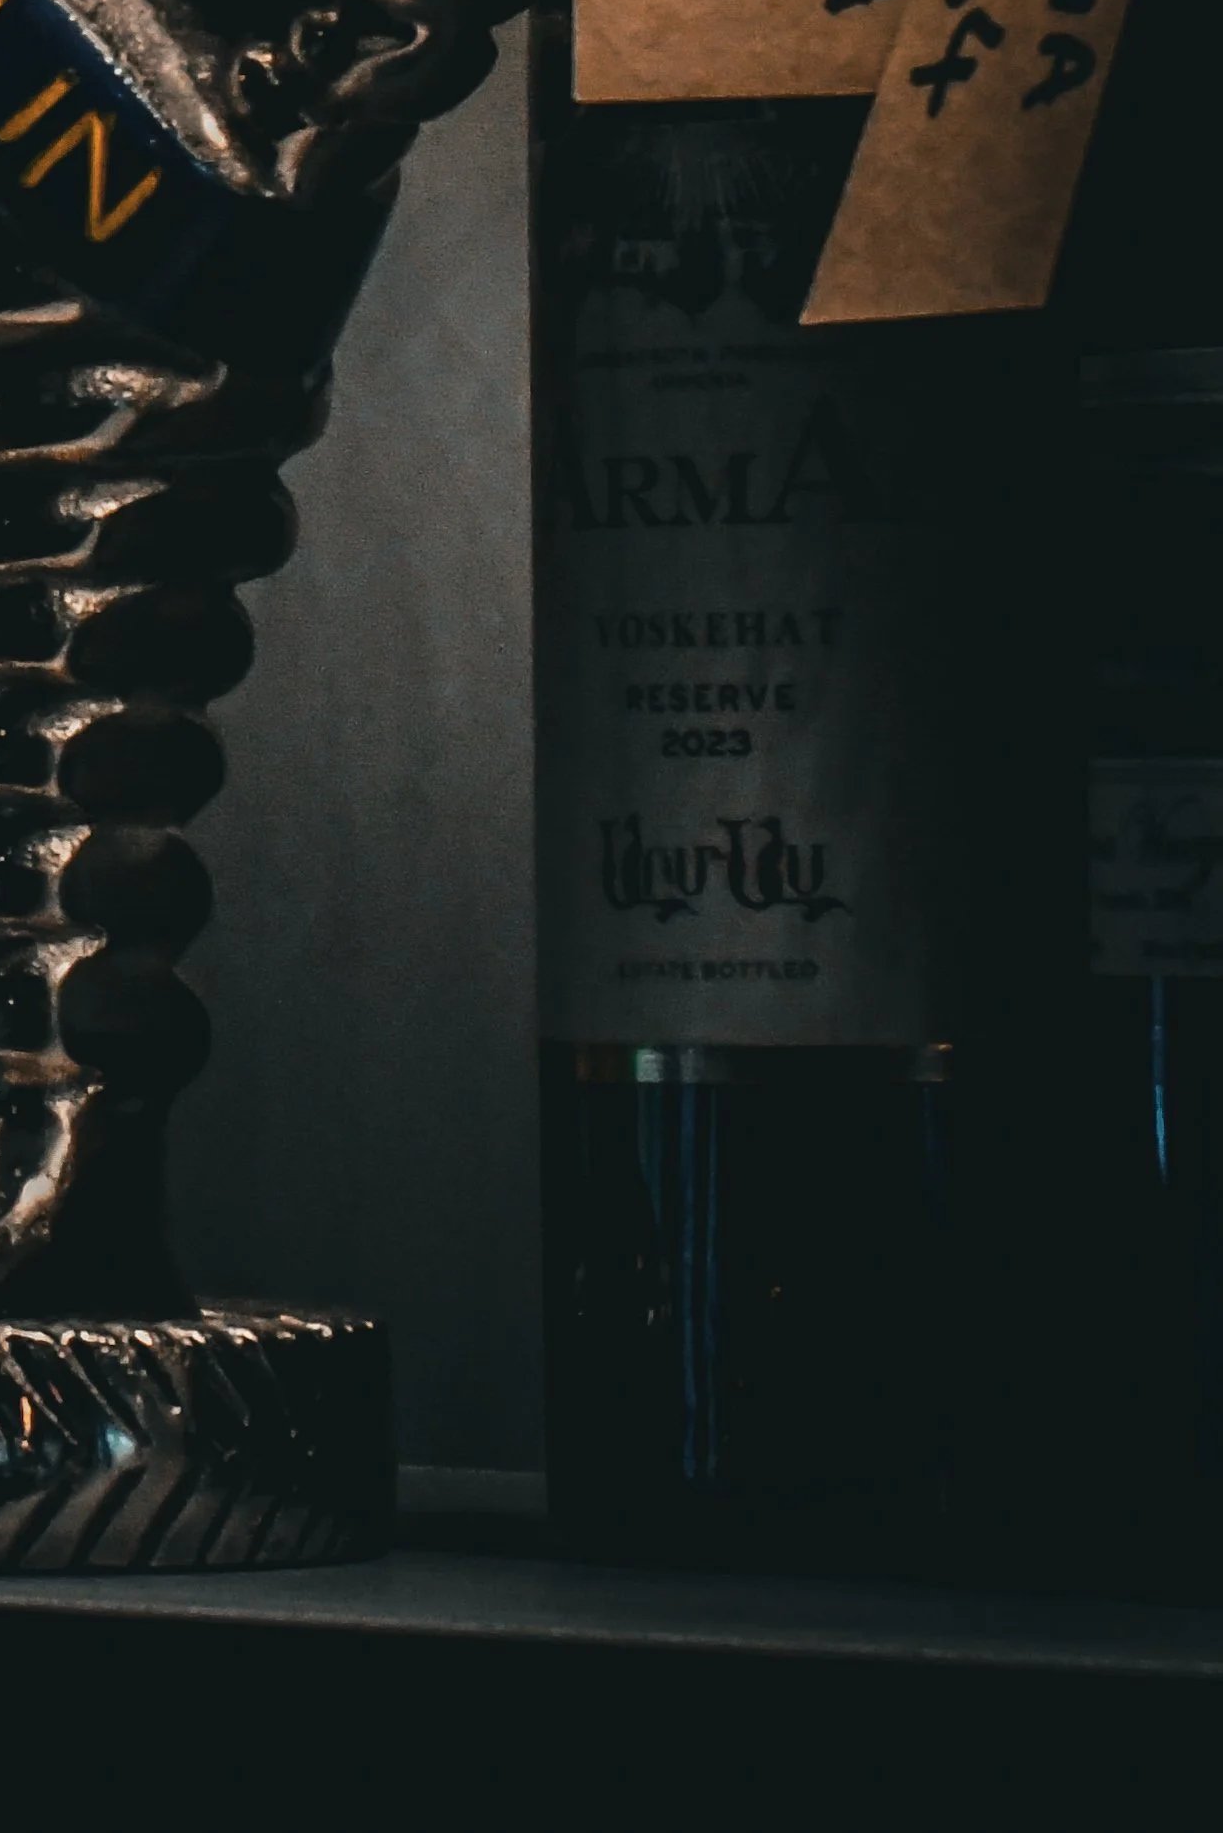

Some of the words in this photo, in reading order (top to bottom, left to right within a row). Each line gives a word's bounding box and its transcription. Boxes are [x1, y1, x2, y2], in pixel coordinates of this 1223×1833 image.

[593, 607, 843, 648] VOSKEHAT
[626, 683, 796, 713] RESERVE
[662, 728, 752, 757] 2023
